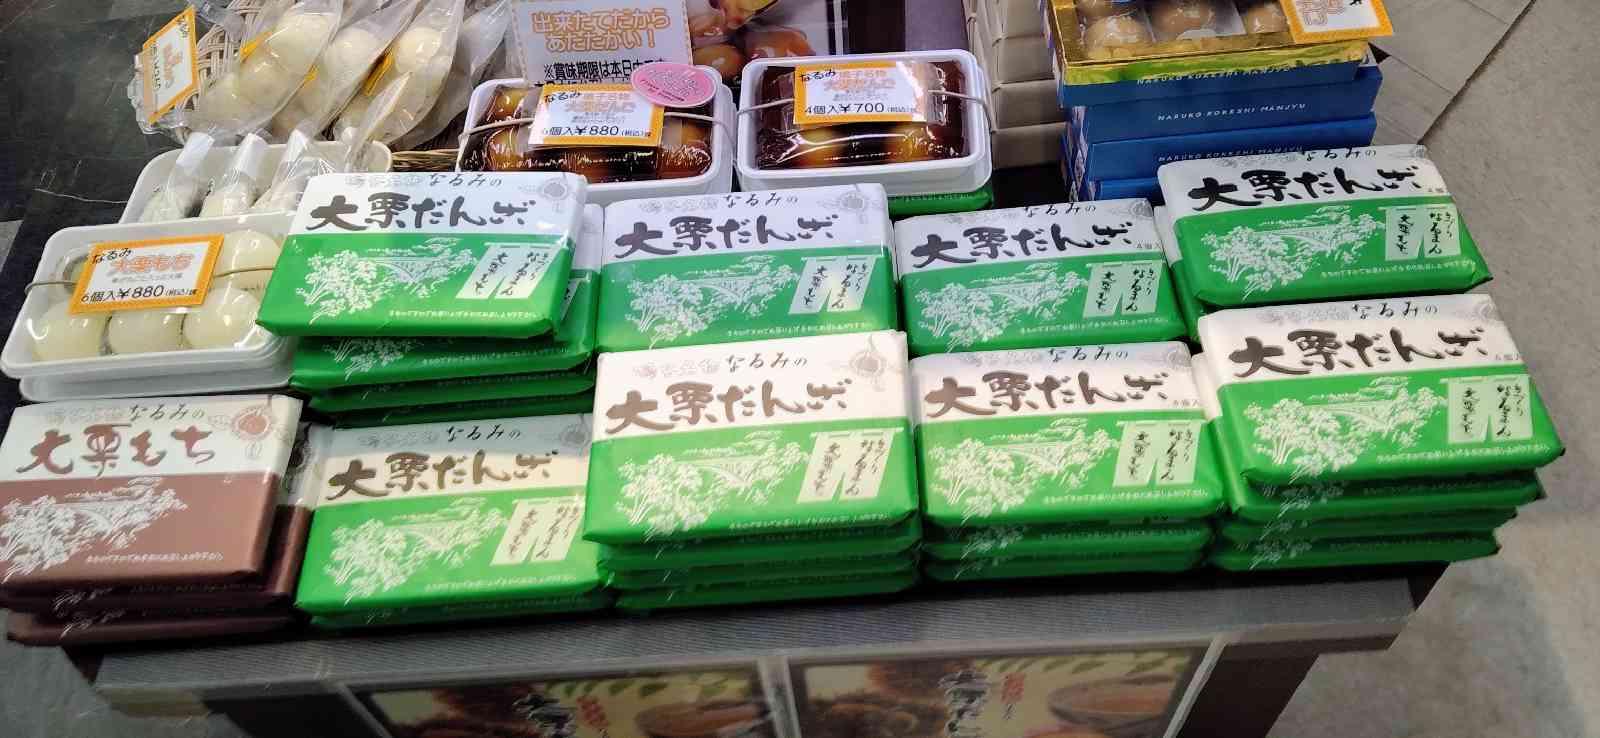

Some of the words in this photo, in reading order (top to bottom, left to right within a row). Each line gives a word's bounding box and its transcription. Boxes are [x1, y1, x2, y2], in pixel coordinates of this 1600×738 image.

[531, 8, 671, 34] 出来たてだから
[543, 57, 665, 79] ※賞味期限は本日
[1157, 111, 1202, 121] NARUKO
[429, 173, 503, 187] なるみの
[725, 352, 809, 373] なるみの
[130, 404, 206, 422] なるみの
[446, 424, 522, 442] なるみの
